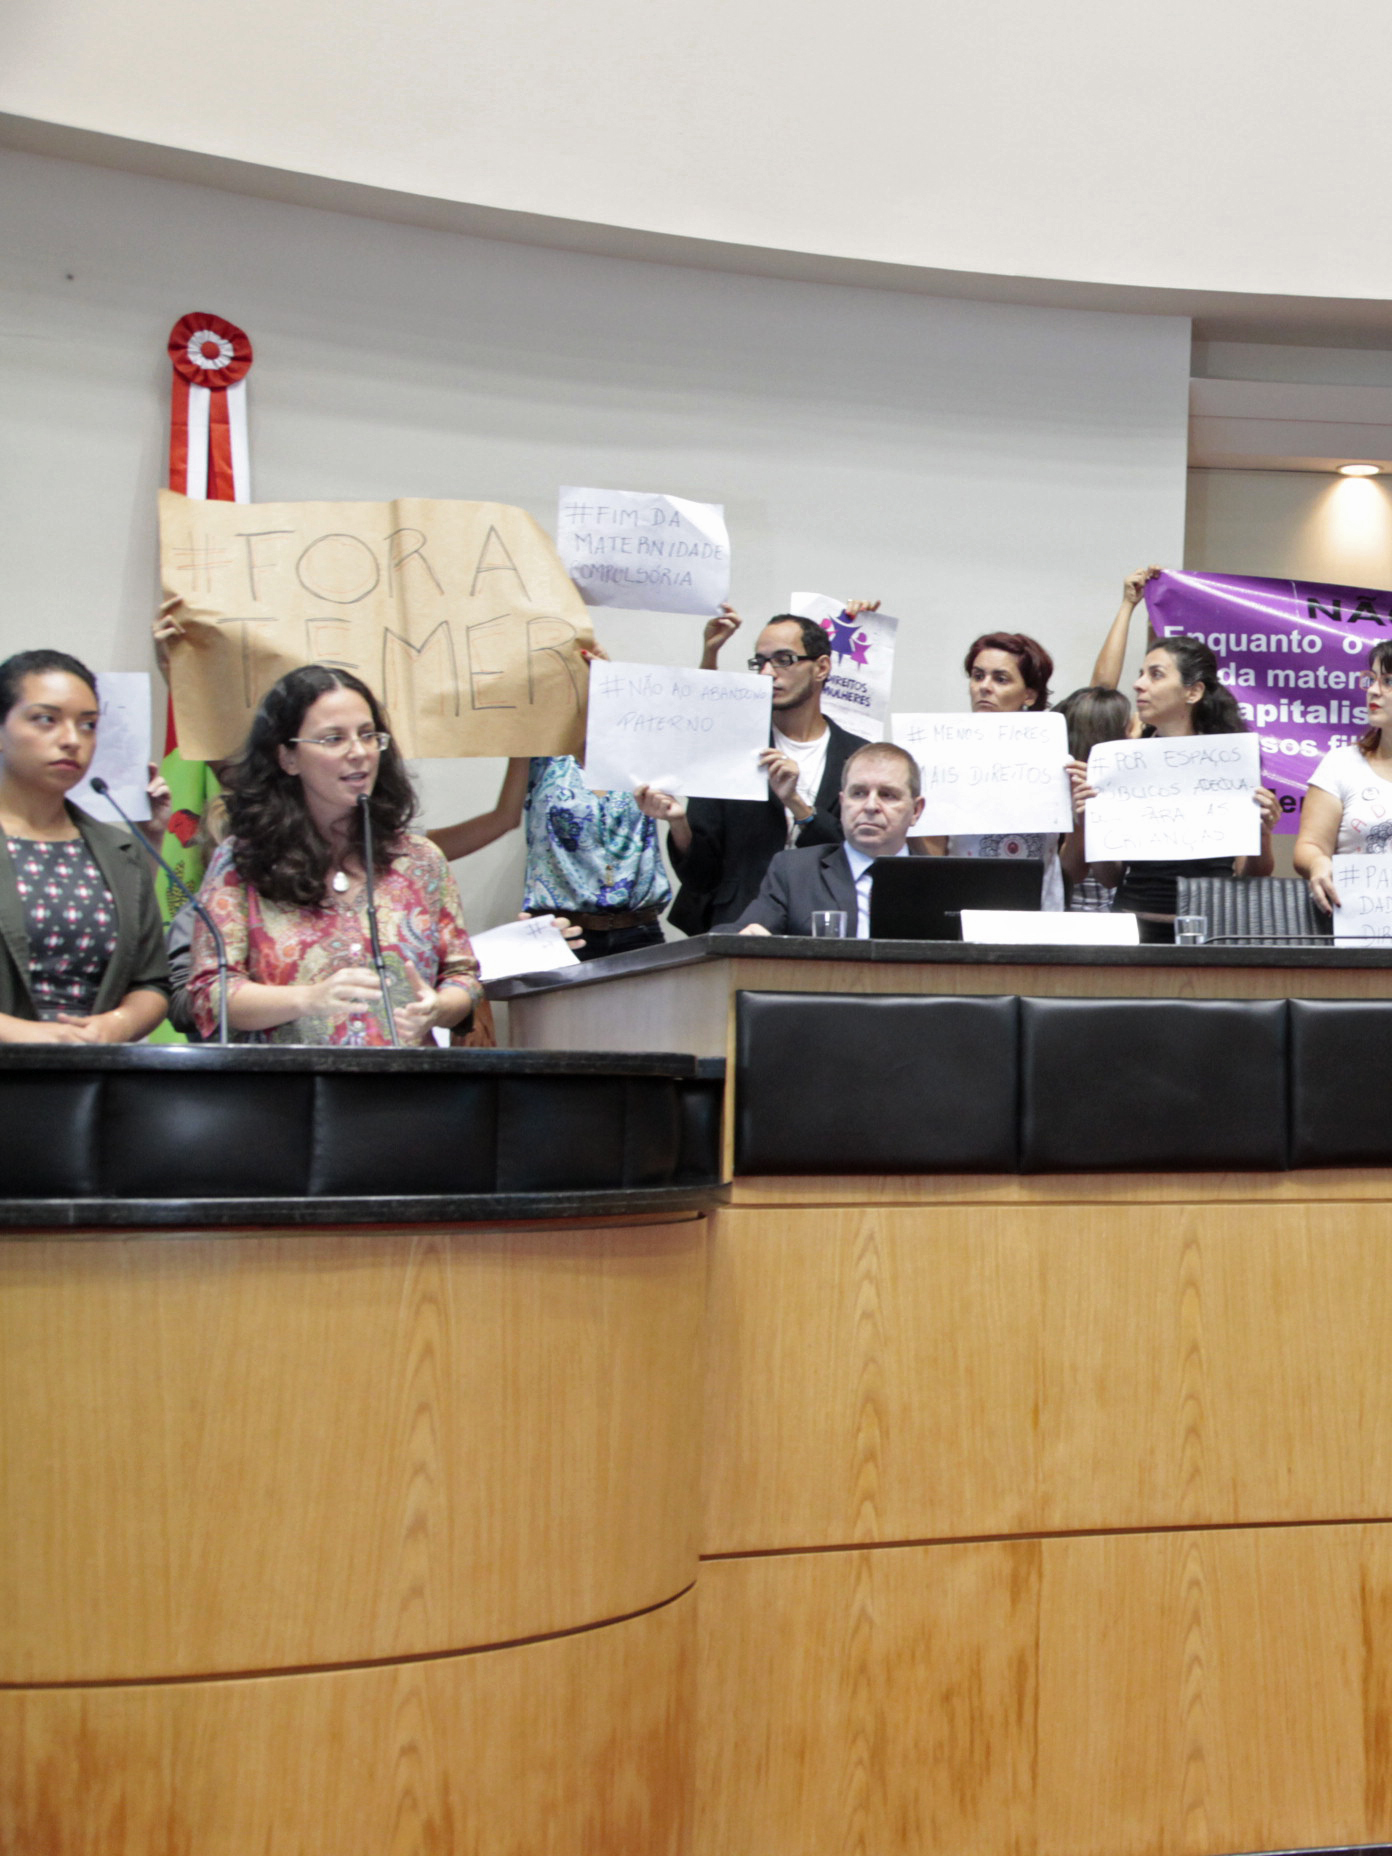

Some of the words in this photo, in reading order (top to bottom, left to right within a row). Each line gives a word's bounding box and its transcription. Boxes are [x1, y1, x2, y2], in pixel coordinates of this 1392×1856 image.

[565, 502, 638, 528] #FIM
[651, 507, 681, 528] DA
[574, 533, 724, 560] MATERNIDADE
[1342, 635, 1362, 654] o
[216, 613, 583, 718] TEMER
[599, 674, 663, 699] #NÃO
[671, 682, 692, 700] AO
[616, 711, 714, 733] PATERNO
[1163, 746, 1242, 768] ESPAÇOS
[968, 763, 1052, 786] DIREITOS
